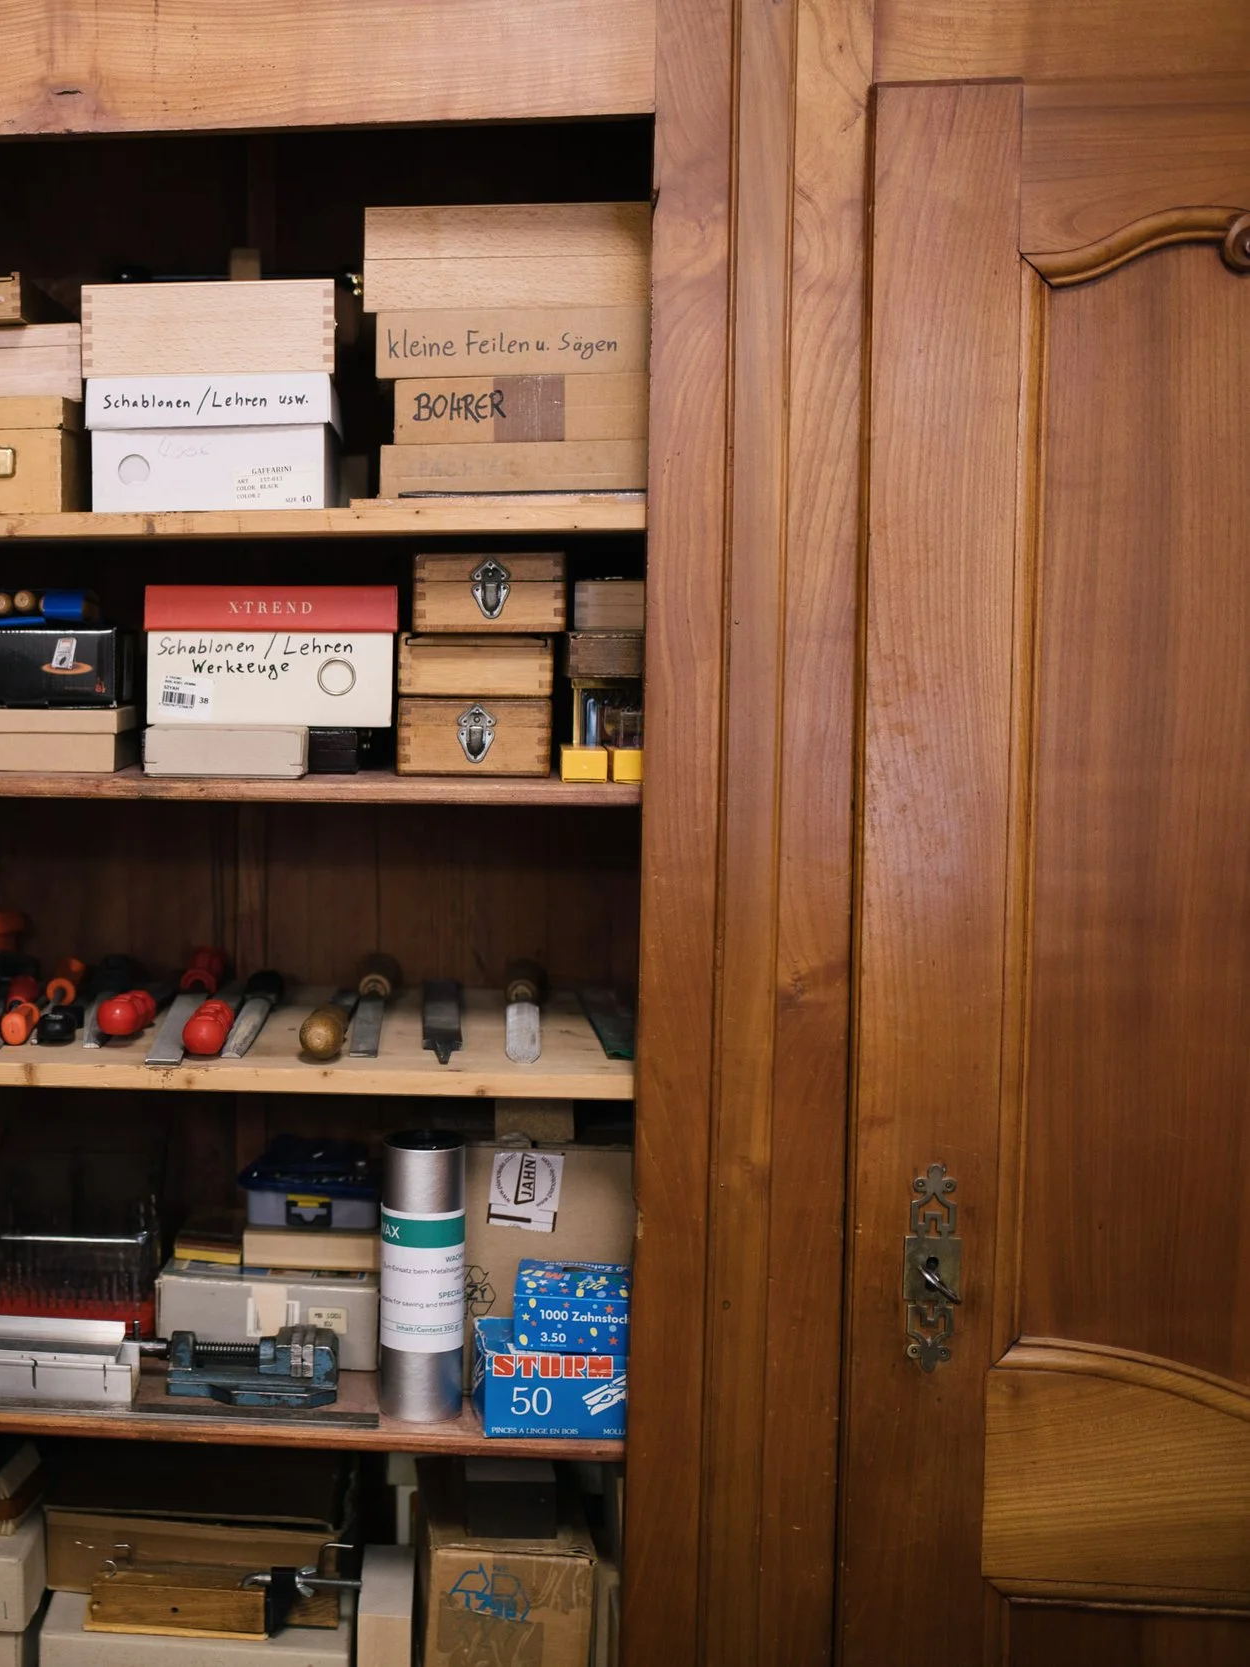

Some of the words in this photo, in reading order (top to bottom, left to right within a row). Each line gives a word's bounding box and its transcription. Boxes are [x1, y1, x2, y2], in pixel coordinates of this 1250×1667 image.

[387, 328, 457, 359] kleine
[465, 329, 530, 357] Feilen
[535, 339, 550, 352] u.
[557, 331, 618, 361] Sägen
[278, 392, 309, 405] usw.
[412, 389, 507, 423] BOHRER
[300, 494, 312, 503] 40
[157, 636, 255, 657] Schablonen
[283, 635, 354, 656] Lehren
[192, 659, 290, 681] Werkzeuge
[520, 1159, 536, 1198] JAHN
[539, 1309, 569, 1321] 1000
[540, 1331, 567, 1343] 3.50
[492, 1354, 614, 1380] STURM
[510, 1386, 553, 1416] 50
[491, 1426, 518, 1434] PINCES
[526, 1427, 548, 1435] LINGE
[550, 1427, 560, 1435] EN
[562, 1427, 579, 1435] BOIS
